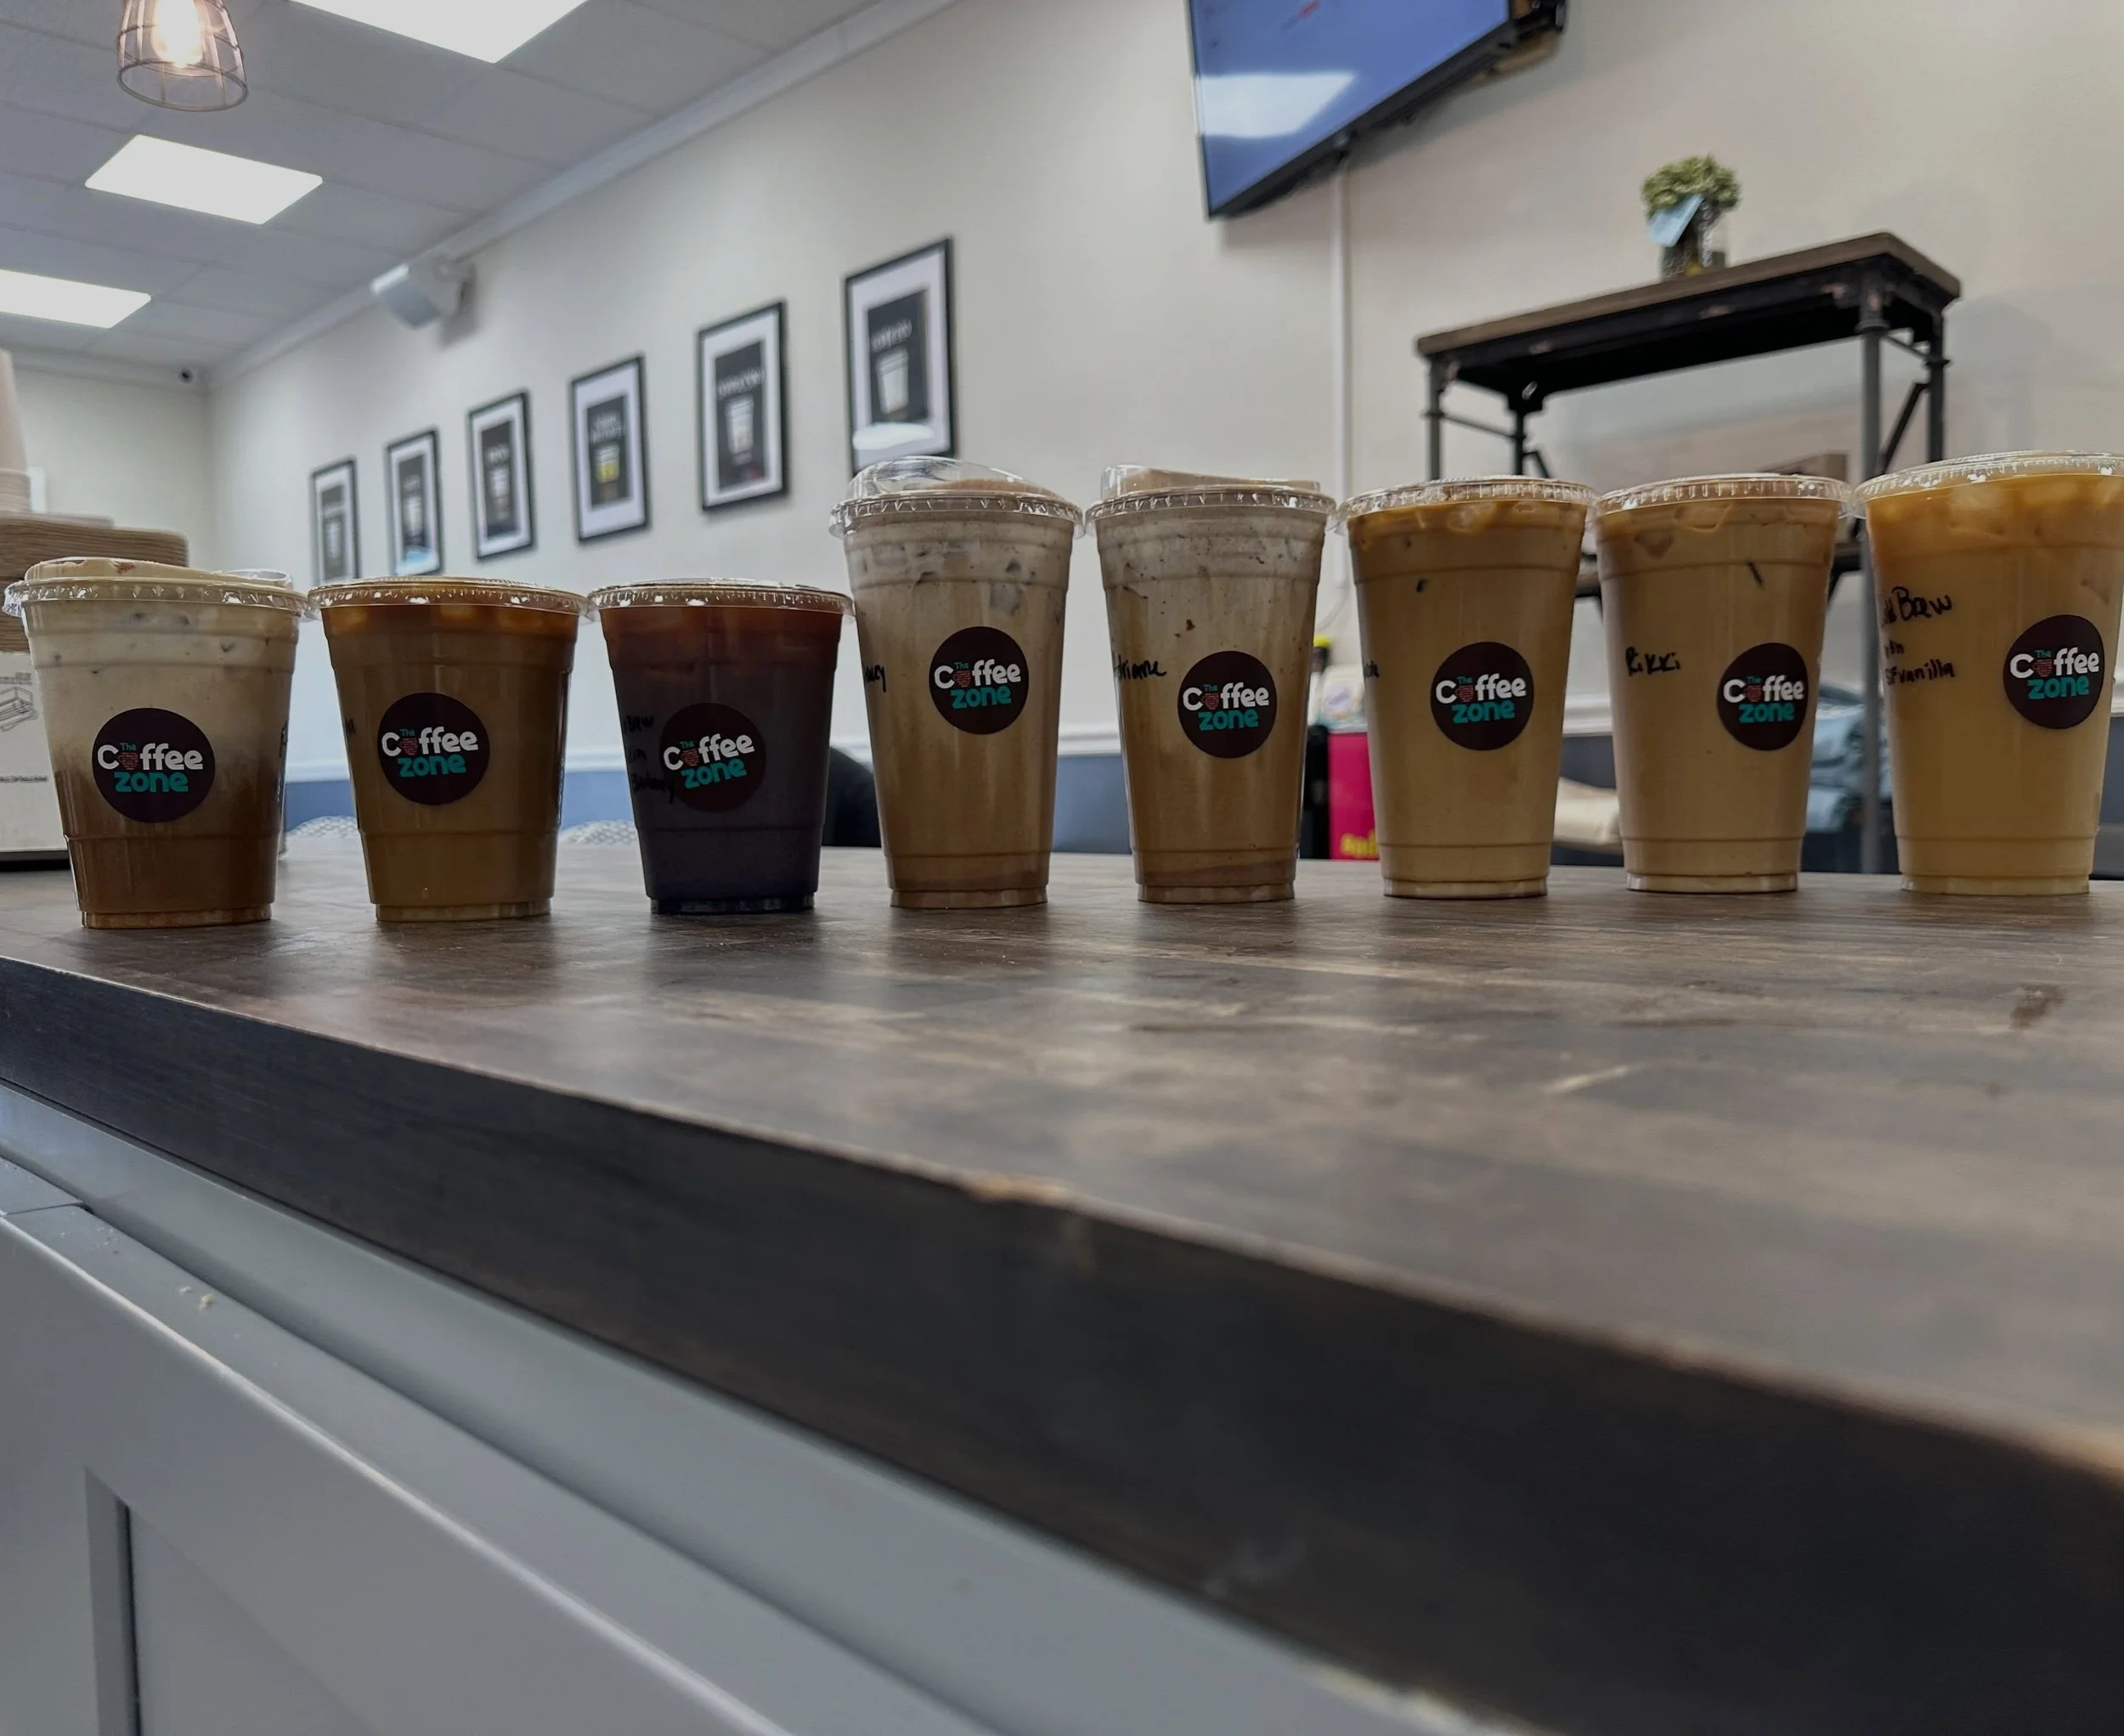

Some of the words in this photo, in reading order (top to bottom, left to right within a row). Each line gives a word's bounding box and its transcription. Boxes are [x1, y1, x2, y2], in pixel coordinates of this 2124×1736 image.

[951, 686, 1012, 709] zone
[2027, 676, 2089, 700] zone
[1198, 710, 1258, 731] zone
[1452, 699, 1515, 724] zone
[1738, 703, 1794, 723] zone
[399, 728, 415, 737] The
[120, 742, 137, 750] The
[680, 740, 694, 749] The
[398, 754, 466, 778] zone
[681, 758, 748, 789] zone
[114, 772, 189, 792] zone
